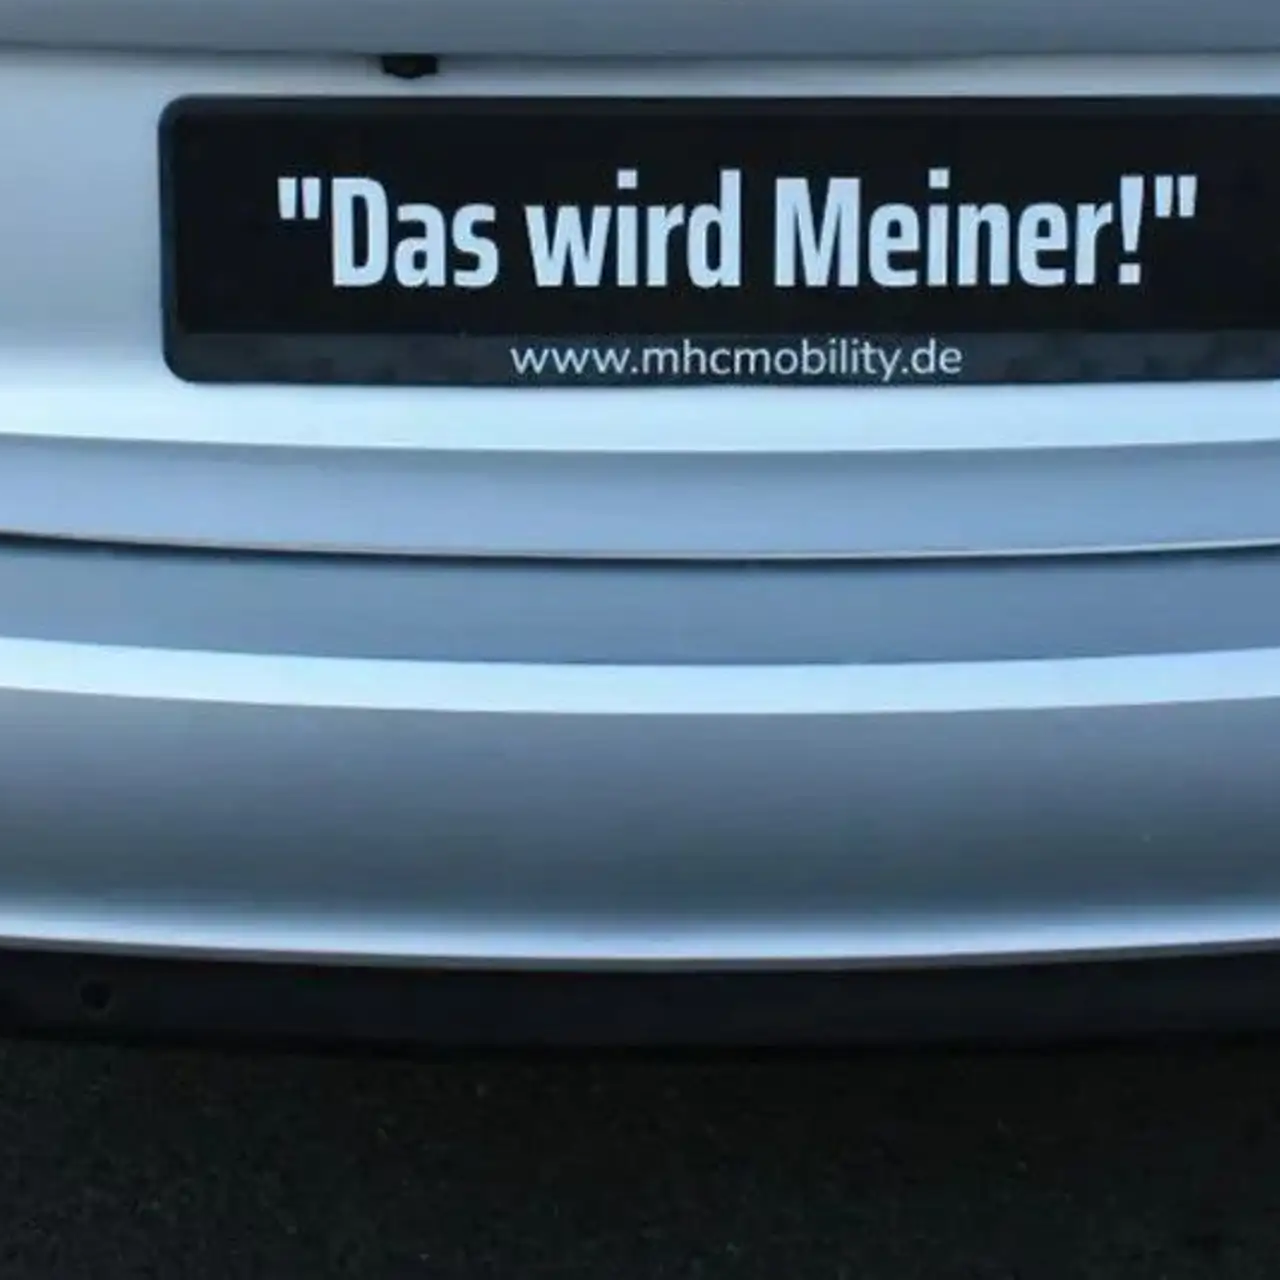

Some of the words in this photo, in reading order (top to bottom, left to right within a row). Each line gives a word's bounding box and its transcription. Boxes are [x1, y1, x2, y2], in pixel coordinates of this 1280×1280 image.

[277, 177, 498, 287] "Das
[524, 169, 741, 287] wird
[774, 168, 1197, 287] Meiner!"
[510, 338, 962, 381] www.mhcmobility.de
